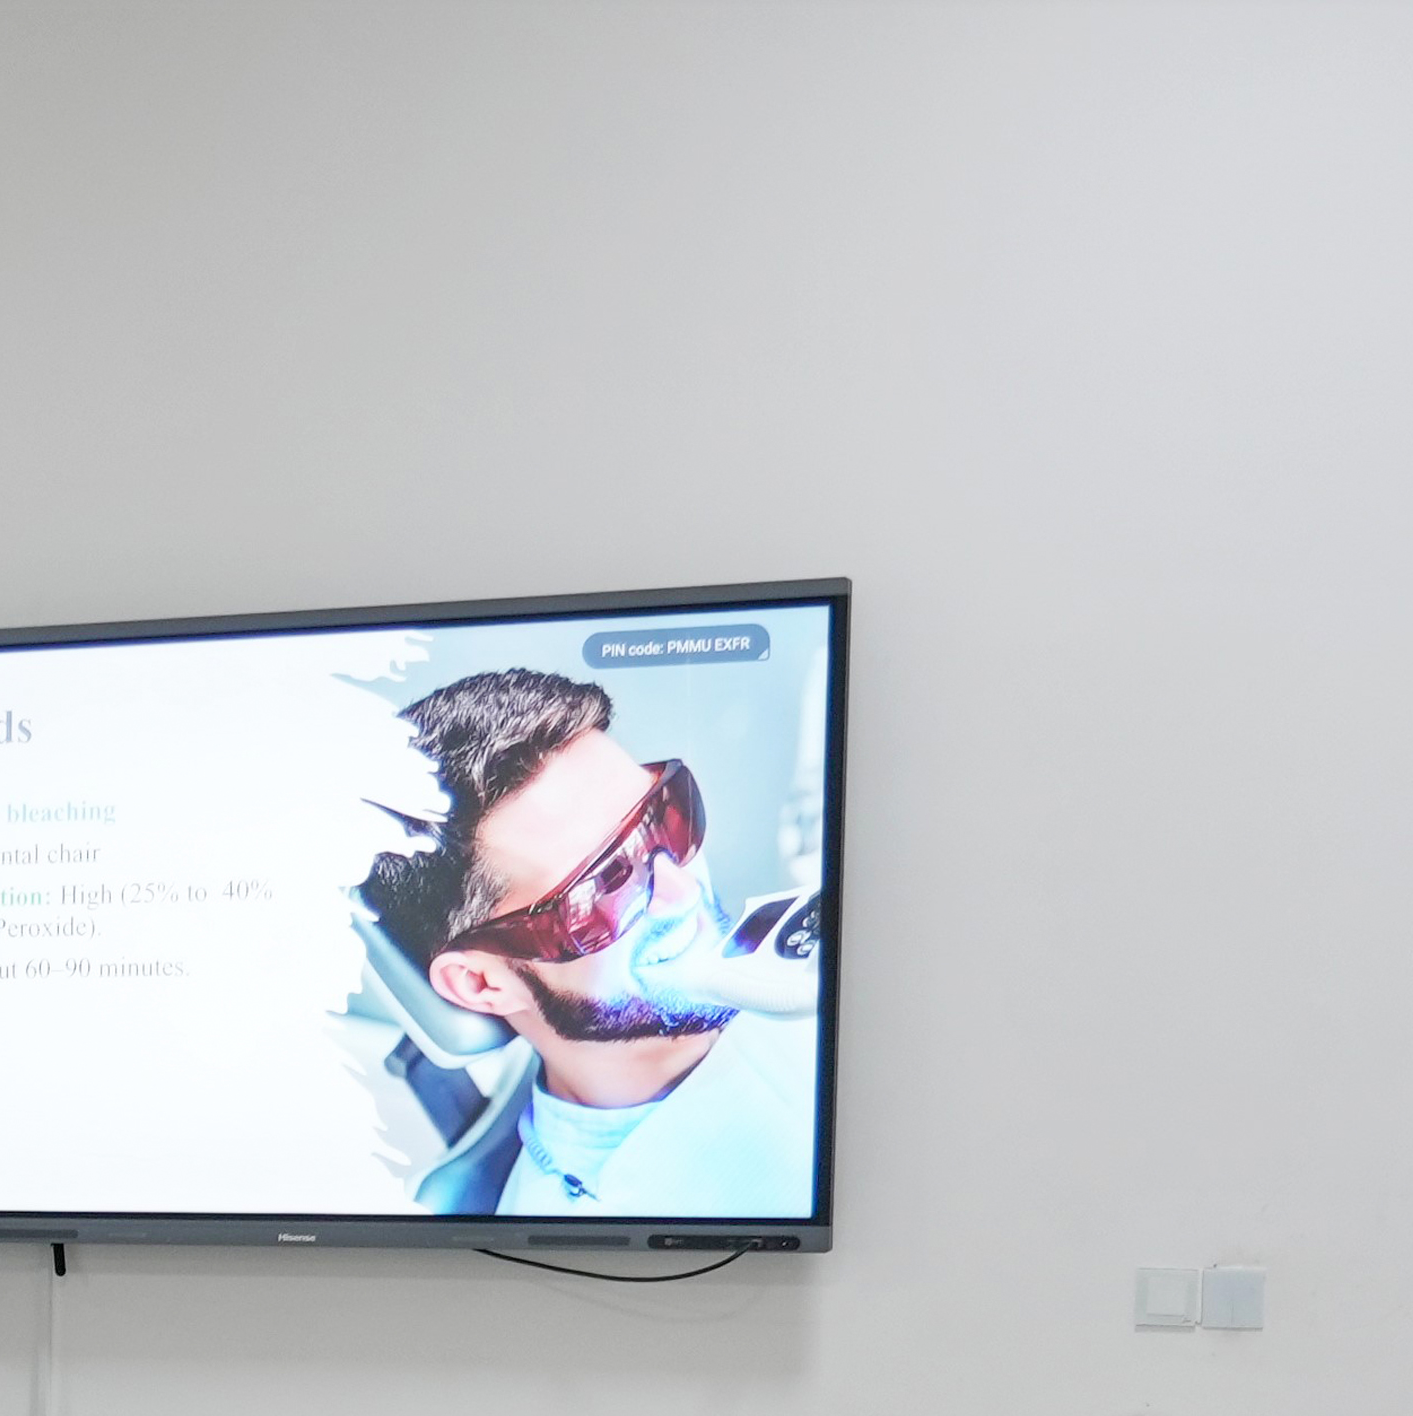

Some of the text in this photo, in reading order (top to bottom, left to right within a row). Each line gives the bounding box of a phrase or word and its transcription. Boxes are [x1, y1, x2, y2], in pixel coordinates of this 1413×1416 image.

[601, 636, 751, 658] PIN code: PMMU EXFR
[7, 800, 116, 825] bleaching
[47, 843, 101, 864] chair
[60, 884, 113, 908] High
[121, 882, 179, 906] (25%
[187, 886, 208, 902] to
[222, 880, 273, 901] 40%
[99, 956, 191, 978] minutes.
